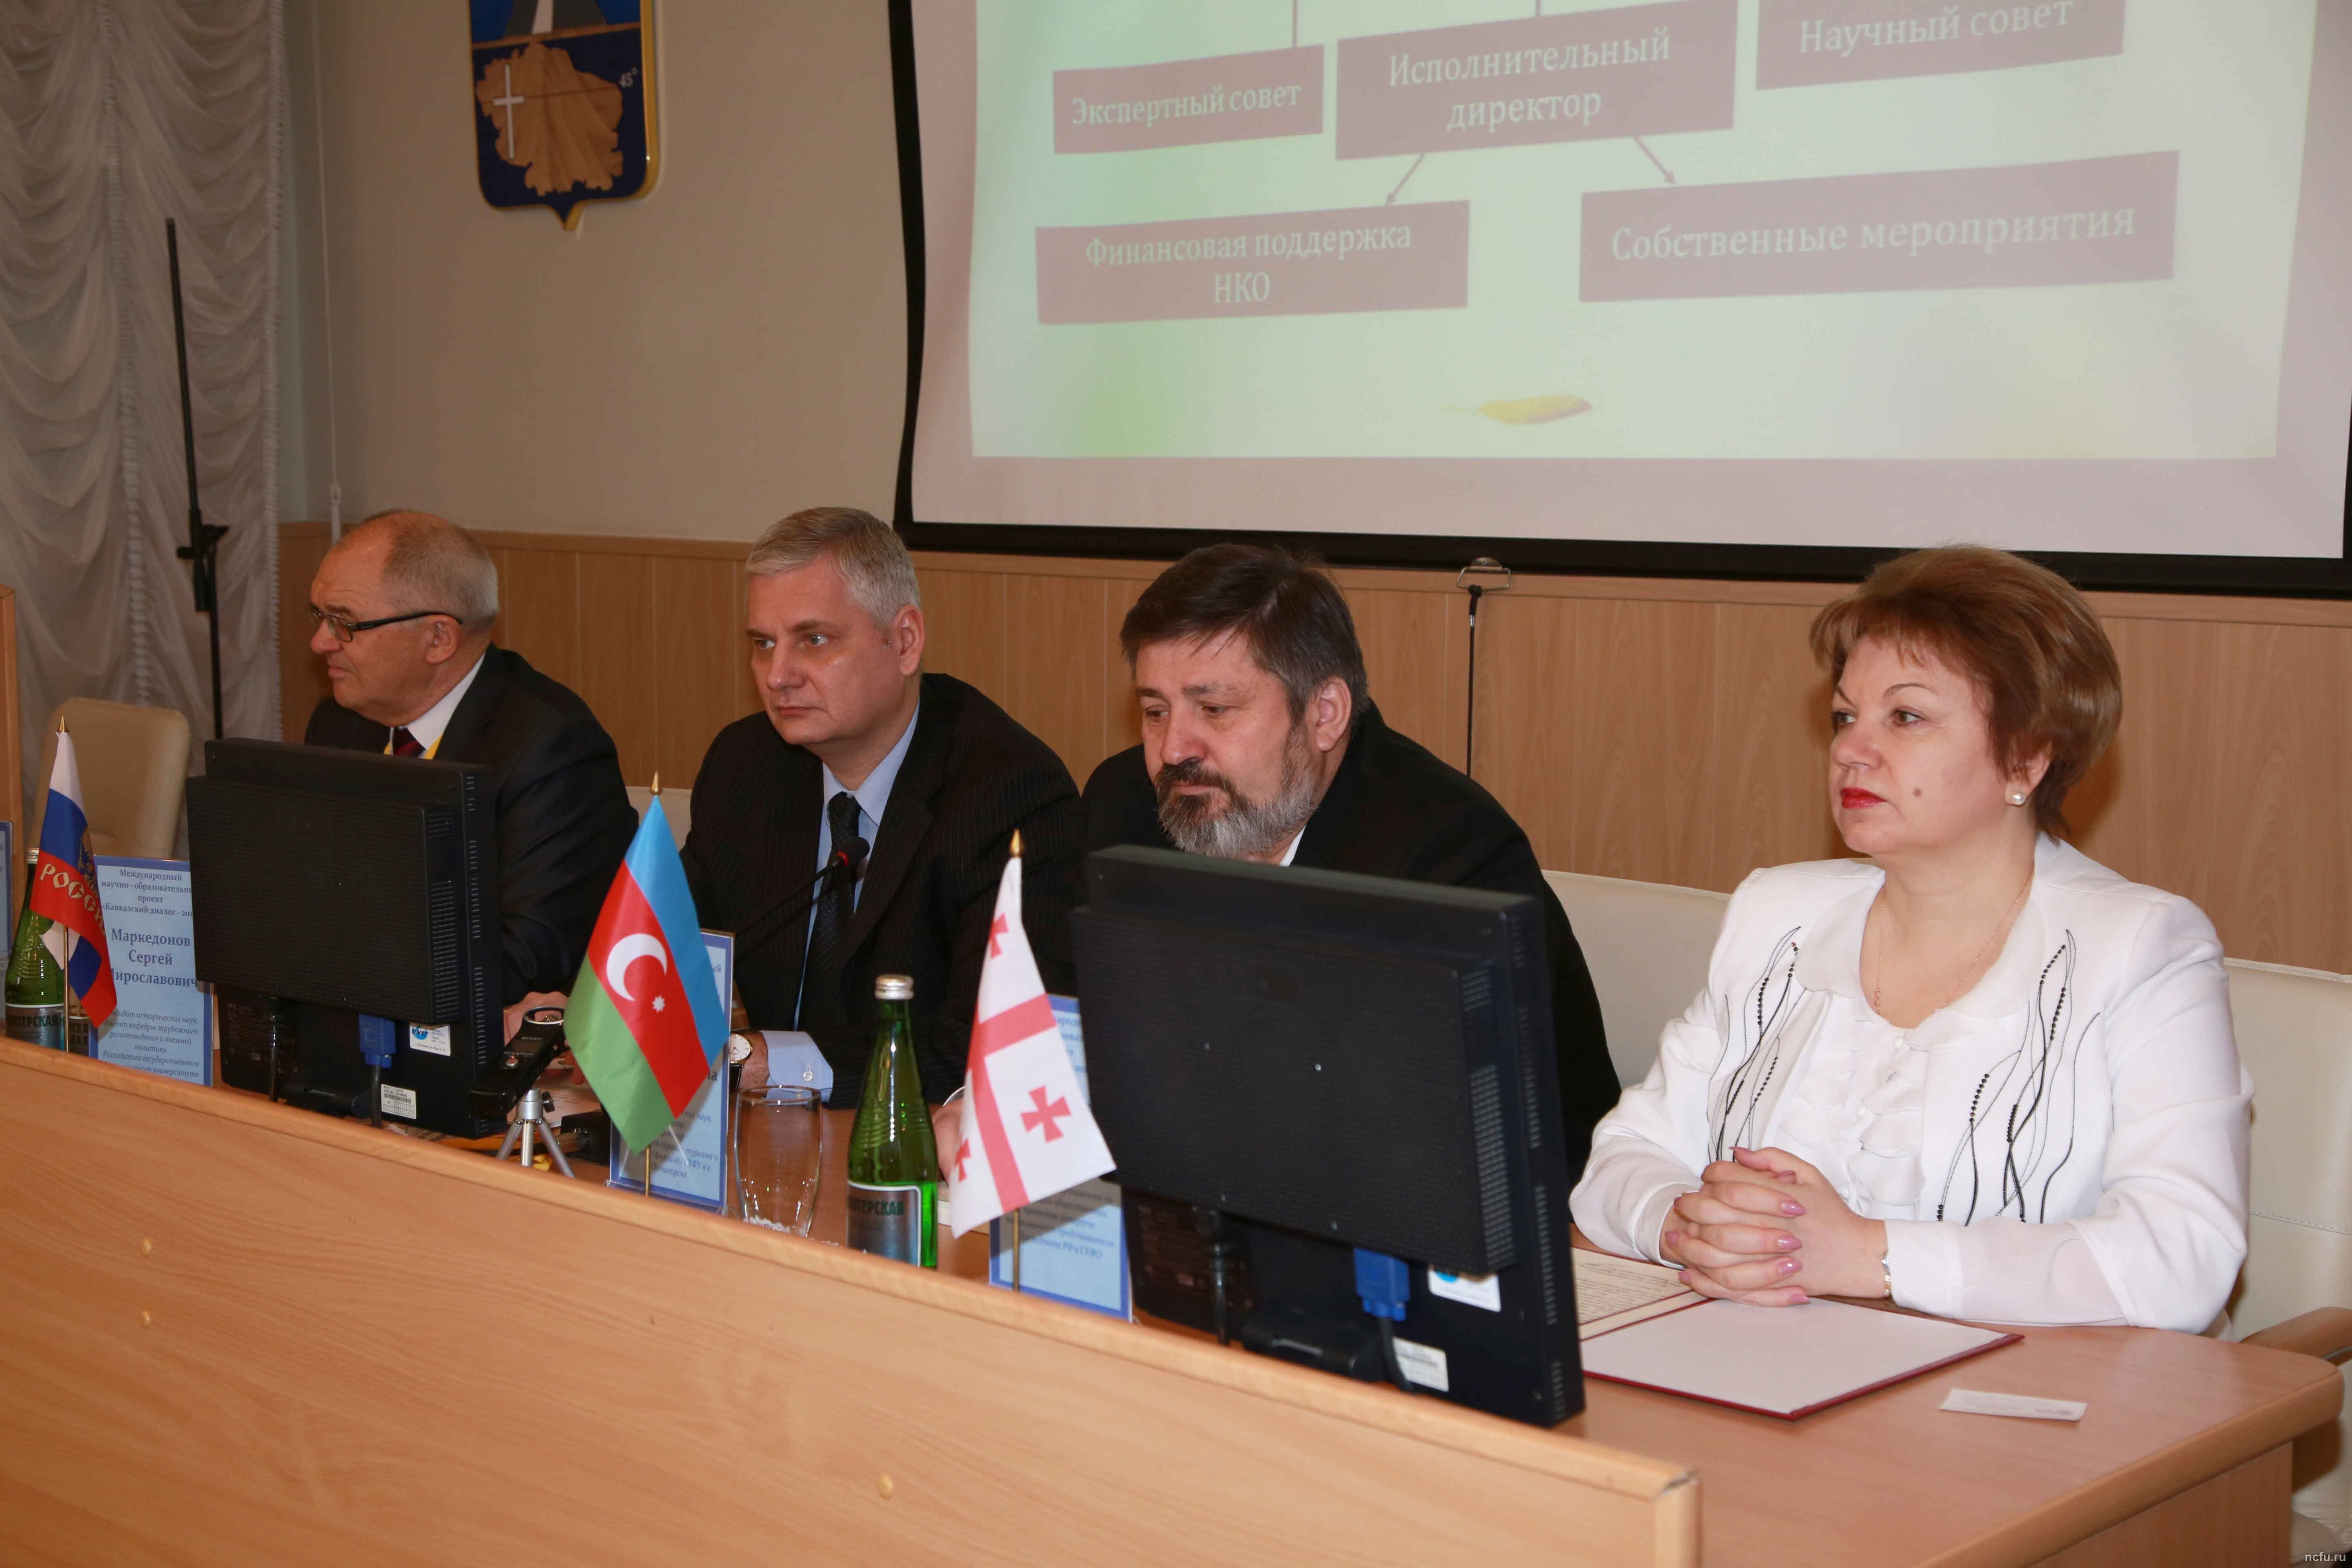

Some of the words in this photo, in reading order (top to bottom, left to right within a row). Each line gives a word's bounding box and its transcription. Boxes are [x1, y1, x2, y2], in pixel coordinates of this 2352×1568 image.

[1799, 6, 1960, 57] Научный
[1971, 0, 2074, 36] совет
[1389, 27, 1670, 87] Исполнительный
[1072, 85, 1224, 127] Экспертный
[1230, 85, 1302, 111] совет
[1448, 92, 1602, 133] директор
[1612, 224, 1847, 261] Собственные
[1860, 209, 2136, 257] мероприятия
[1085, 235, 1247, 267] Финансовая
[1254, 225, 1411, 260] поддержка
[1214, 271, 1270, 304] НКО
[120, 869, 182, 881] Международный
[102, 881, 129, 889] научно
[138, 895, 163, 903] проект
[111, 928, 191, 947] Маркедонов
[129, 949, 173, 967] Сергей
[137, 1013, 180, 1022] исторических
[109, 1031, 158, 1042] регионоведения
[129, 1022, 155, 1032] кафедры
[157, 1025, 198, 1035] зарубежного
[134, 1044, 167, 1053] политики
[103, 1050, 141, 1060] Российского
[142, 1055, 199, 1067] государственного
[153, 1069, 199, 1078] университета
